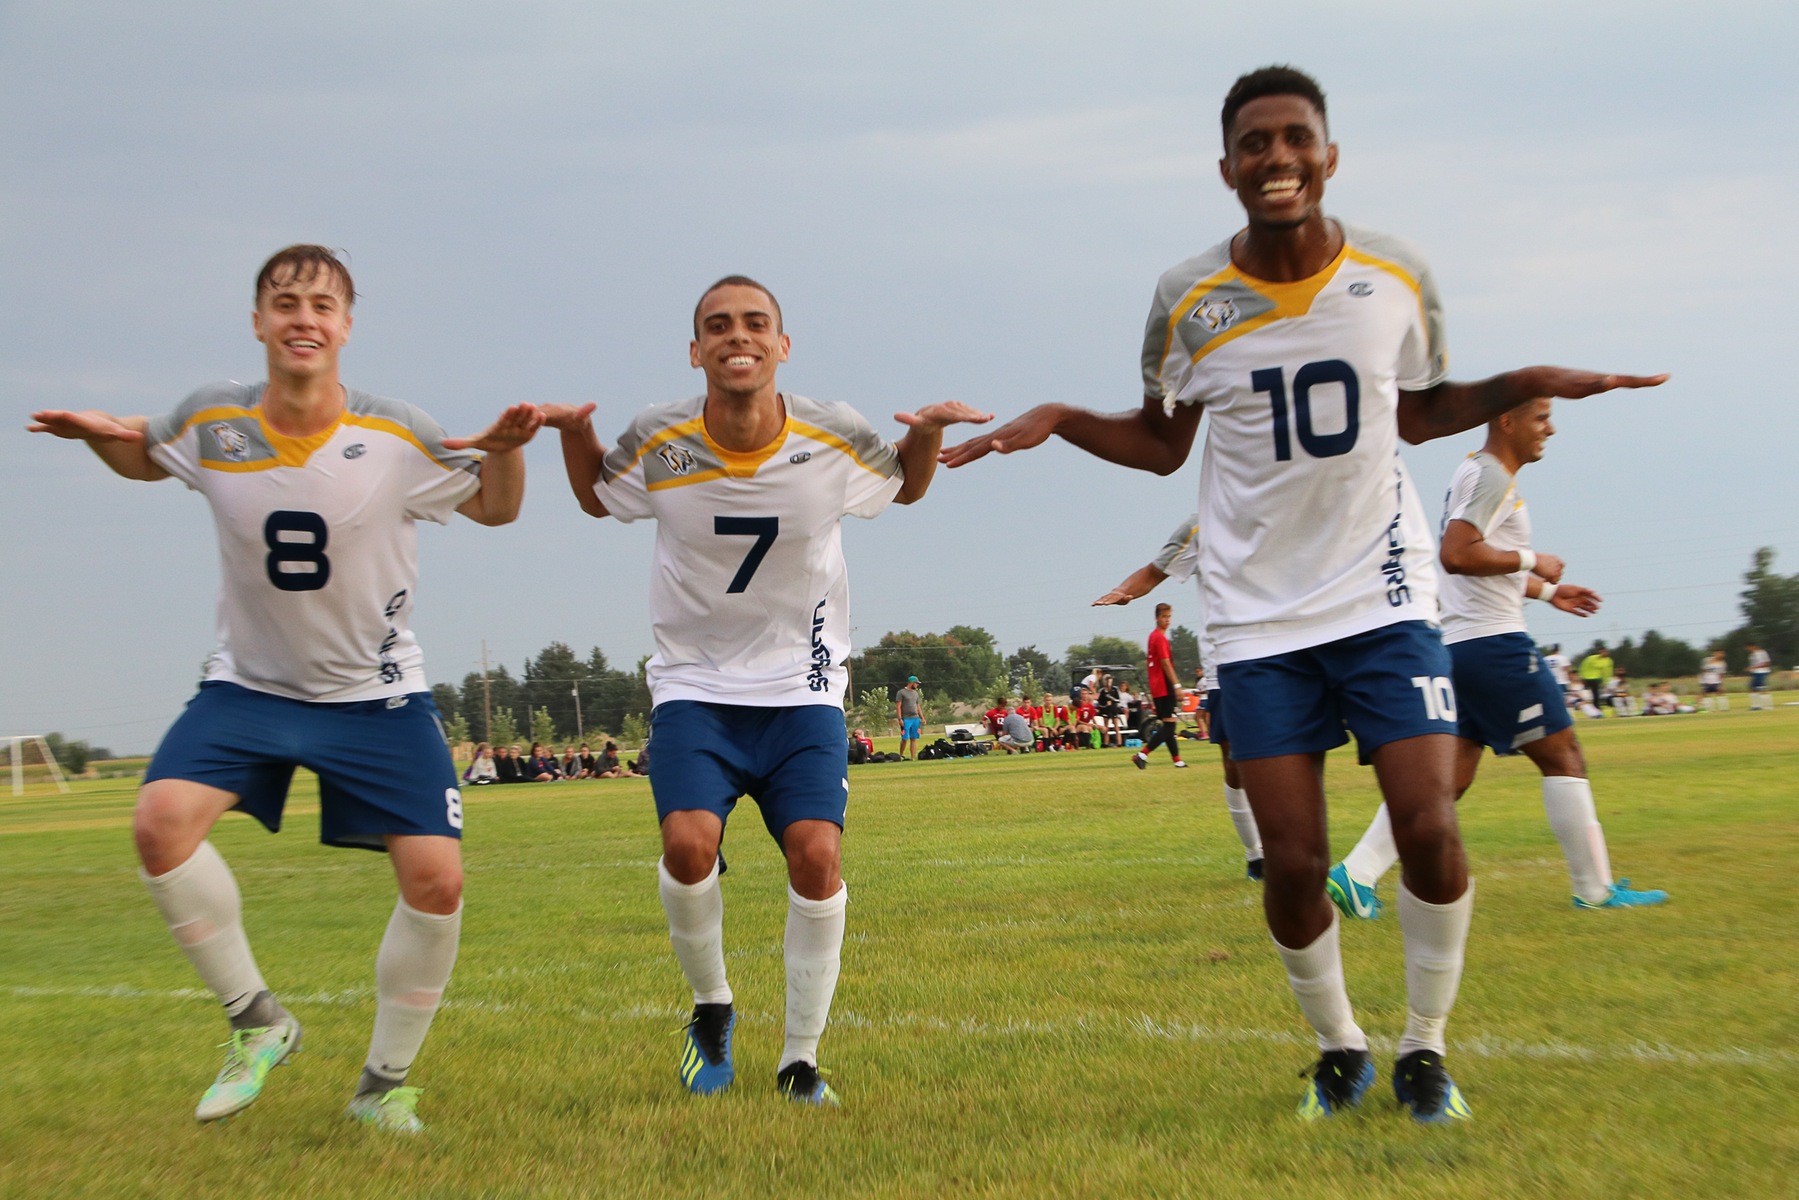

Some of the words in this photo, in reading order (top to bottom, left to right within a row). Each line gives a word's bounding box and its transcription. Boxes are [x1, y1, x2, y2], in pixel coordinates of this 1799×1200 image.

[1251, 358, 1360, 461] 10
[263, 511, 331, 591] 8
[714, 516, 778, 593] 7
[1410, 675, 1457, 722] 10
[445, 787, 464, 830] 8
